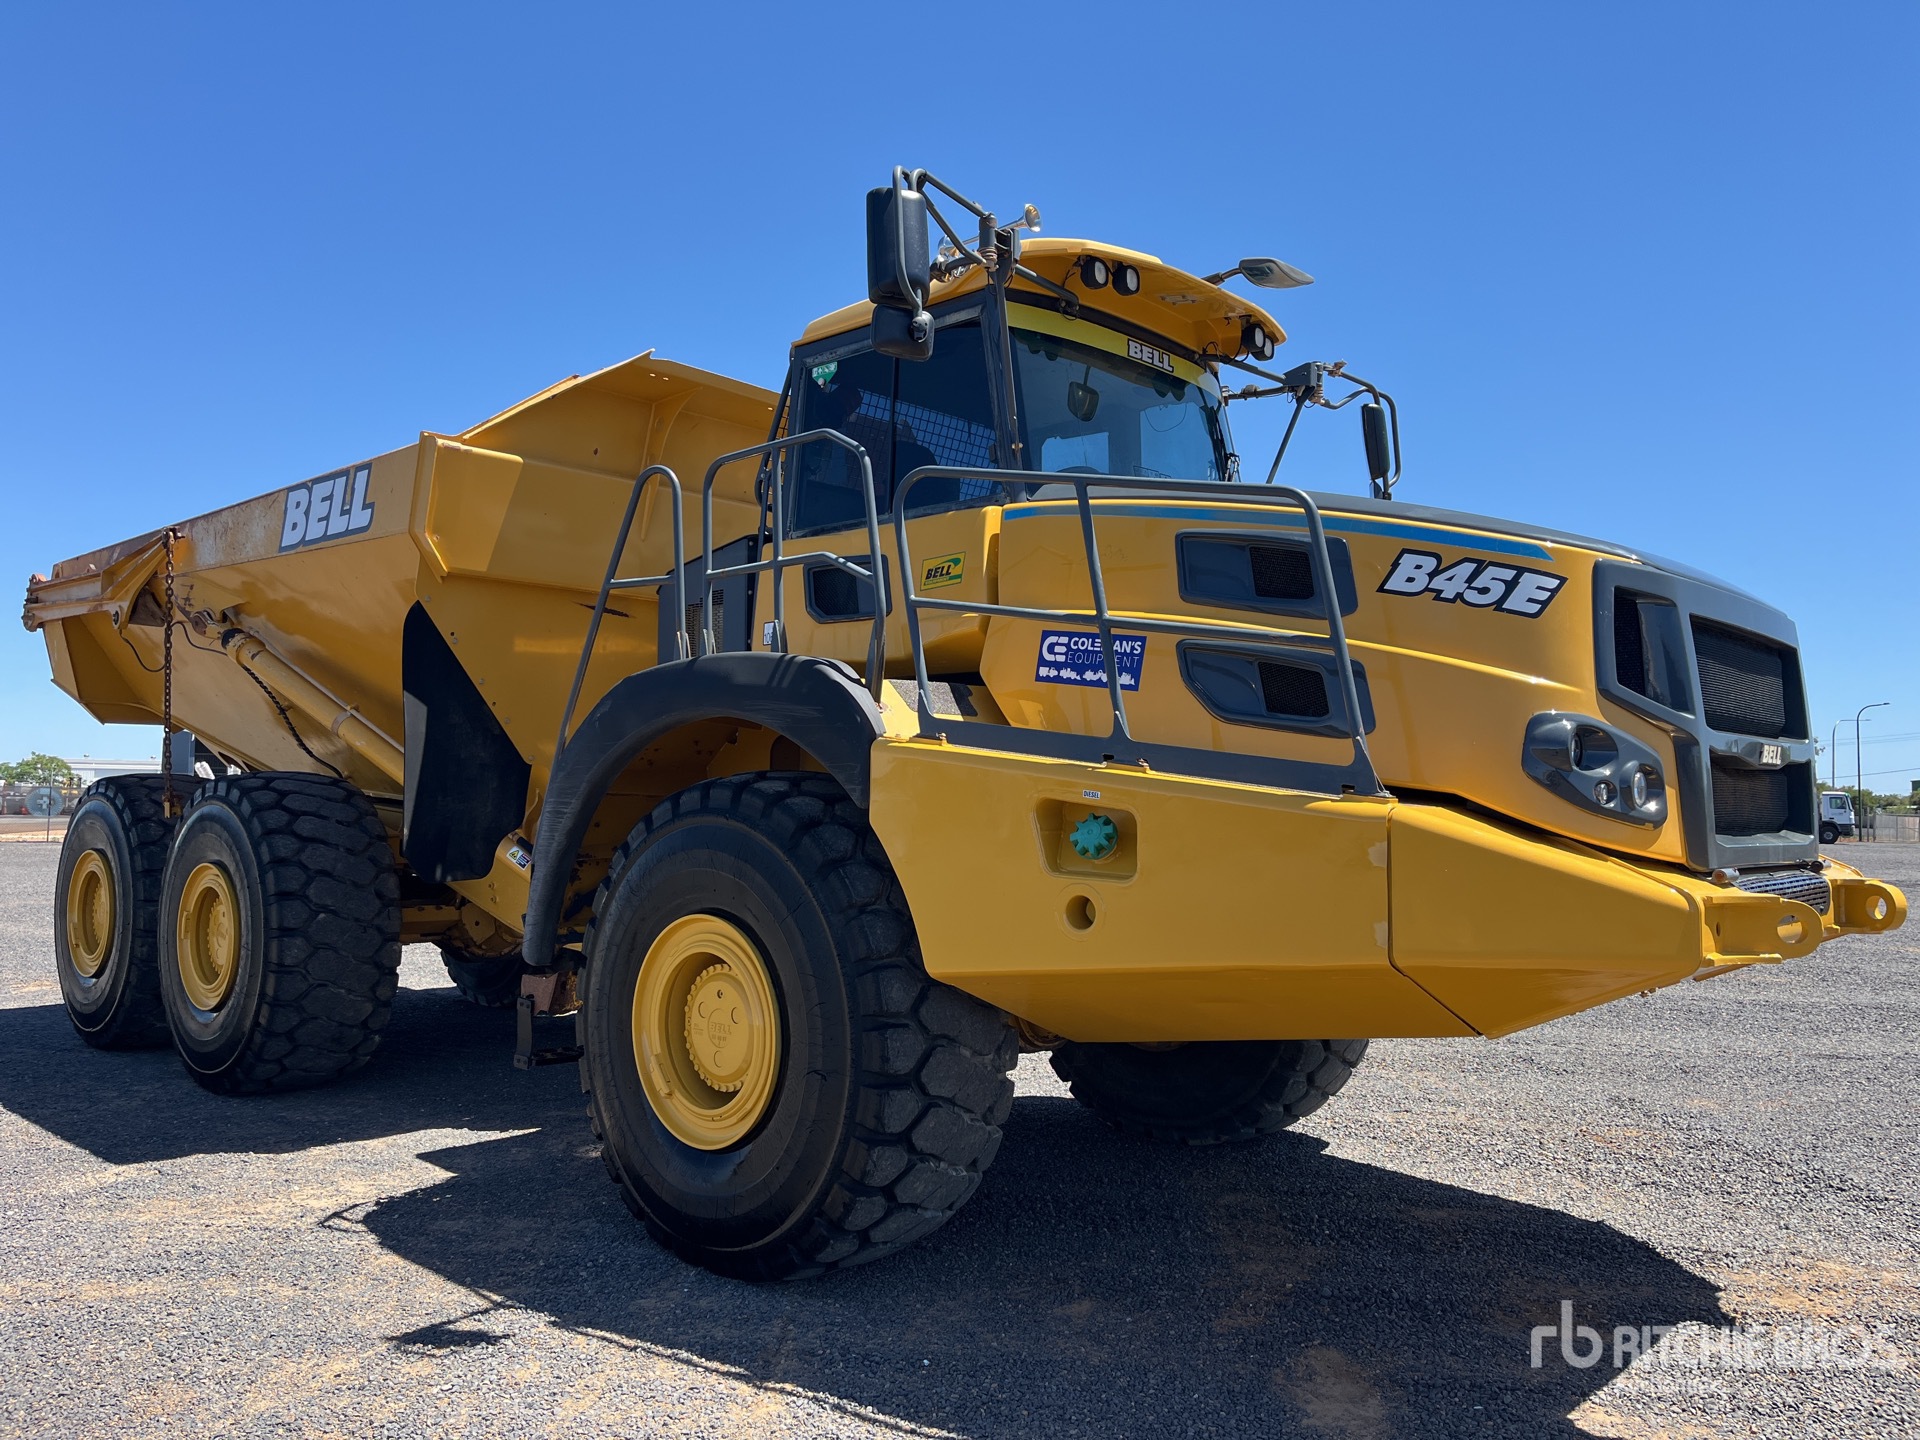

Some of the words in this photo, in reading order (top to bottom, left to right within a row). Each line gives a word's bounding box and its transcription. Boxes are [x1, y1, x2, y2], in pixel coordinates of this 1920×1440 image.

[1128, 339, 1174, 372] BELL
[280, 466, 373, 550] BELL
[925, 565, 952, 580] BELL
[1380, 551, 1564, 616] B45E
[1070, 637, 1142, 654] COLEAN'S
[1067, 651, 1139, 668] EQUIPENT
[1763, 744, 1782, 765] BELL
[1083, 790, 1100, 799] DIESEL
